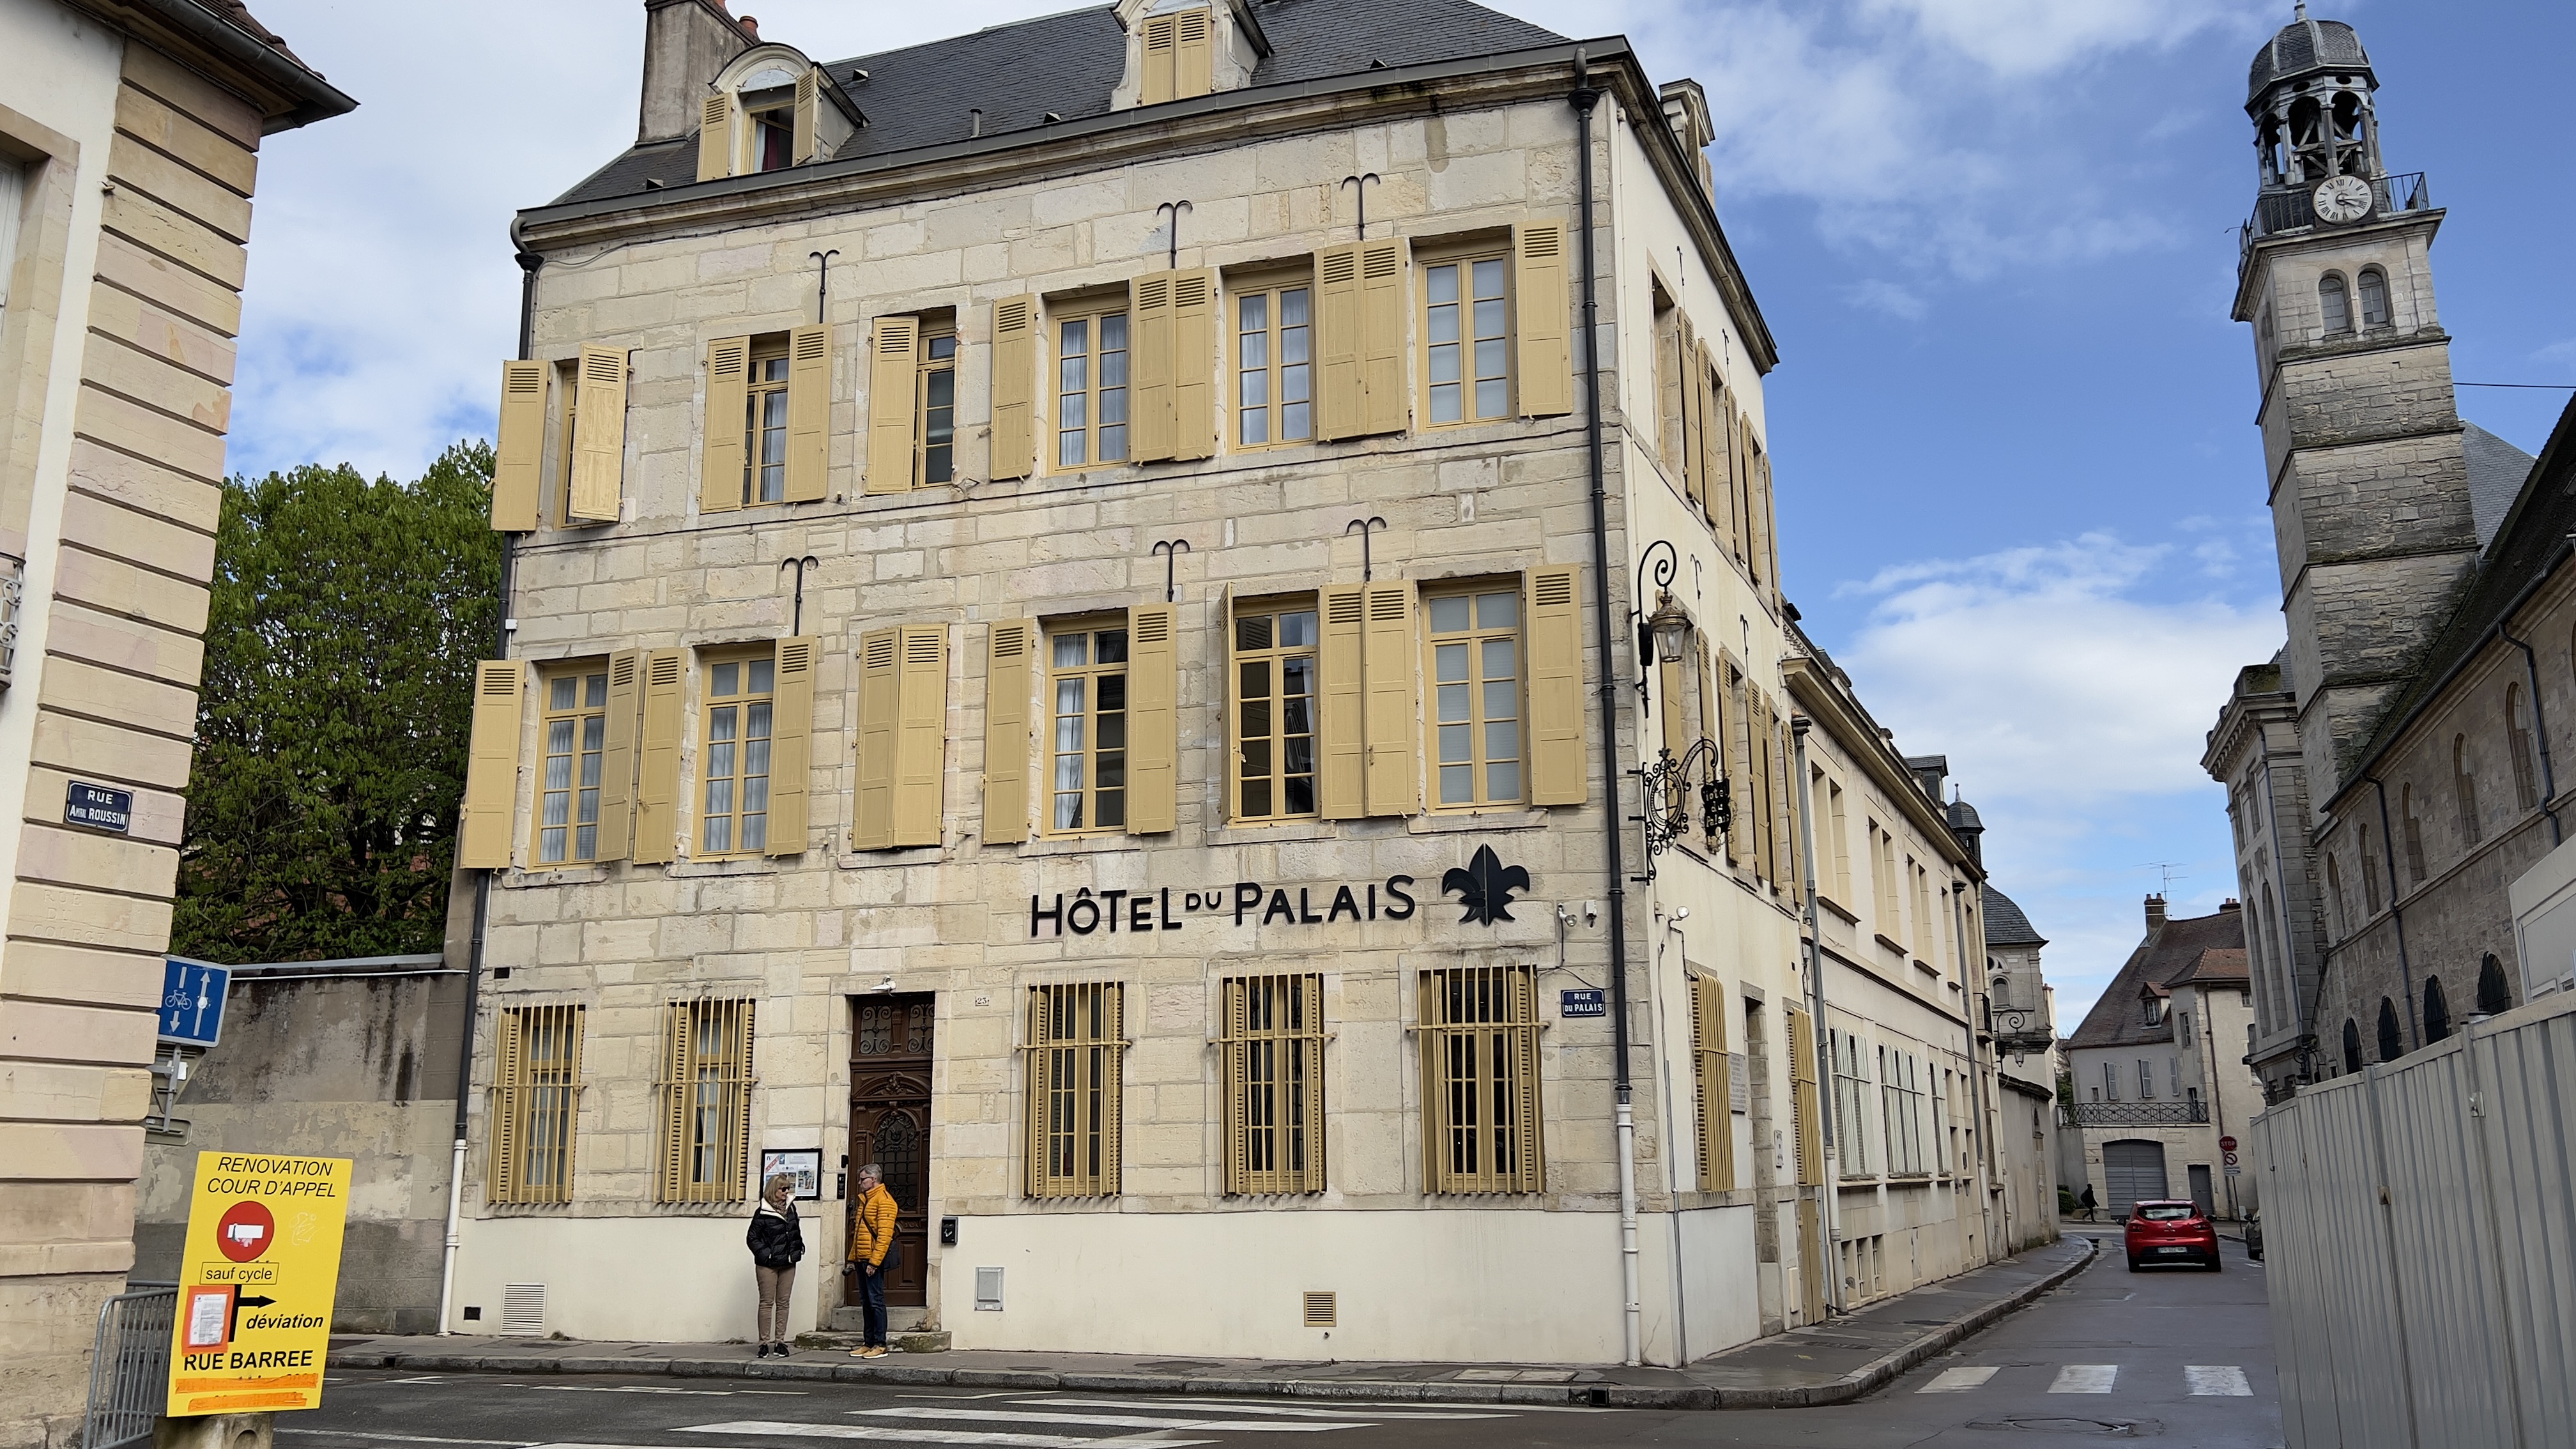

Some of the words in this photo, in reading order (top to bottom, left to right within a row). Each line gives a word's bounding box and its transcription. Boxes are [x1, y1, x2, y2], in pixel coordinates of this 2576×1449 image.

[88, 790, 113, 804] RUE
[88, 808, 126, 825] ROUSSIN
[44, 889, 81, 906] RUE
[1031, 887, 1183, 937] HÔTEL
[1185, 891, 1222, 910] DU
[1235, 875, 1416, 925] PALAIS
[1574, 1003, 1603, 1012] PALAIS
[218, 1156, 333, 1176] RENOVATION
[208, 1177, 261, 1195] COUR
[264, 1180, 336, 1197] D'APPEL
[206, 1267, 236, 1280] sauf
[238, 1268, 273, 1283] cycle
[246, 1314, 324, 1330] déviation
[184, 1353, 224, 1371] RUE
[230, 1350, 313, 1369] BARREE
